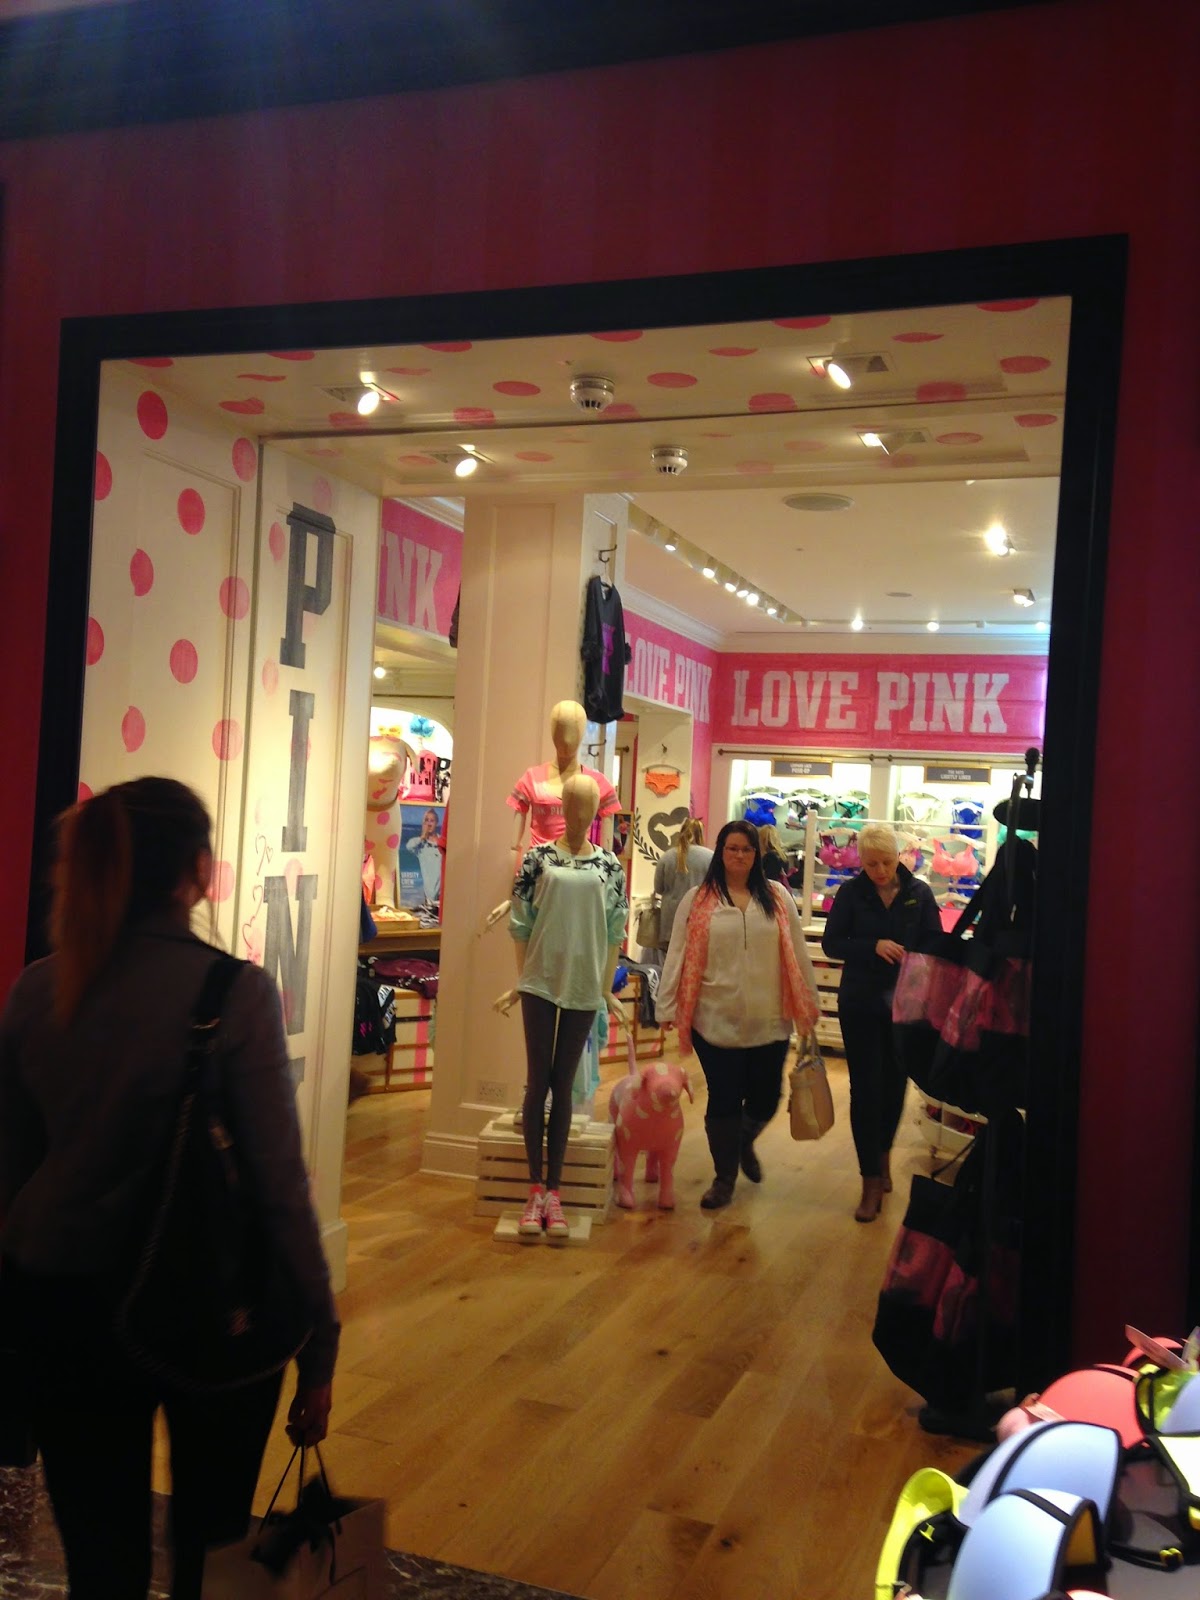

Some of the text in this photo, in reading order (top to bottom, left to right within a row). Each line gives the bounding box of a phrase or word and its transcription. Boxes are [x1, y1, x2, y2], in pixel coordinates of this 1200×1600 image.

[379, 529, 443, 633] NK
[673, 653, 712, 724] PINK
[731, 670, 1010, 734] LOVE PINK
[262, 502, 336, 1083] PIN
